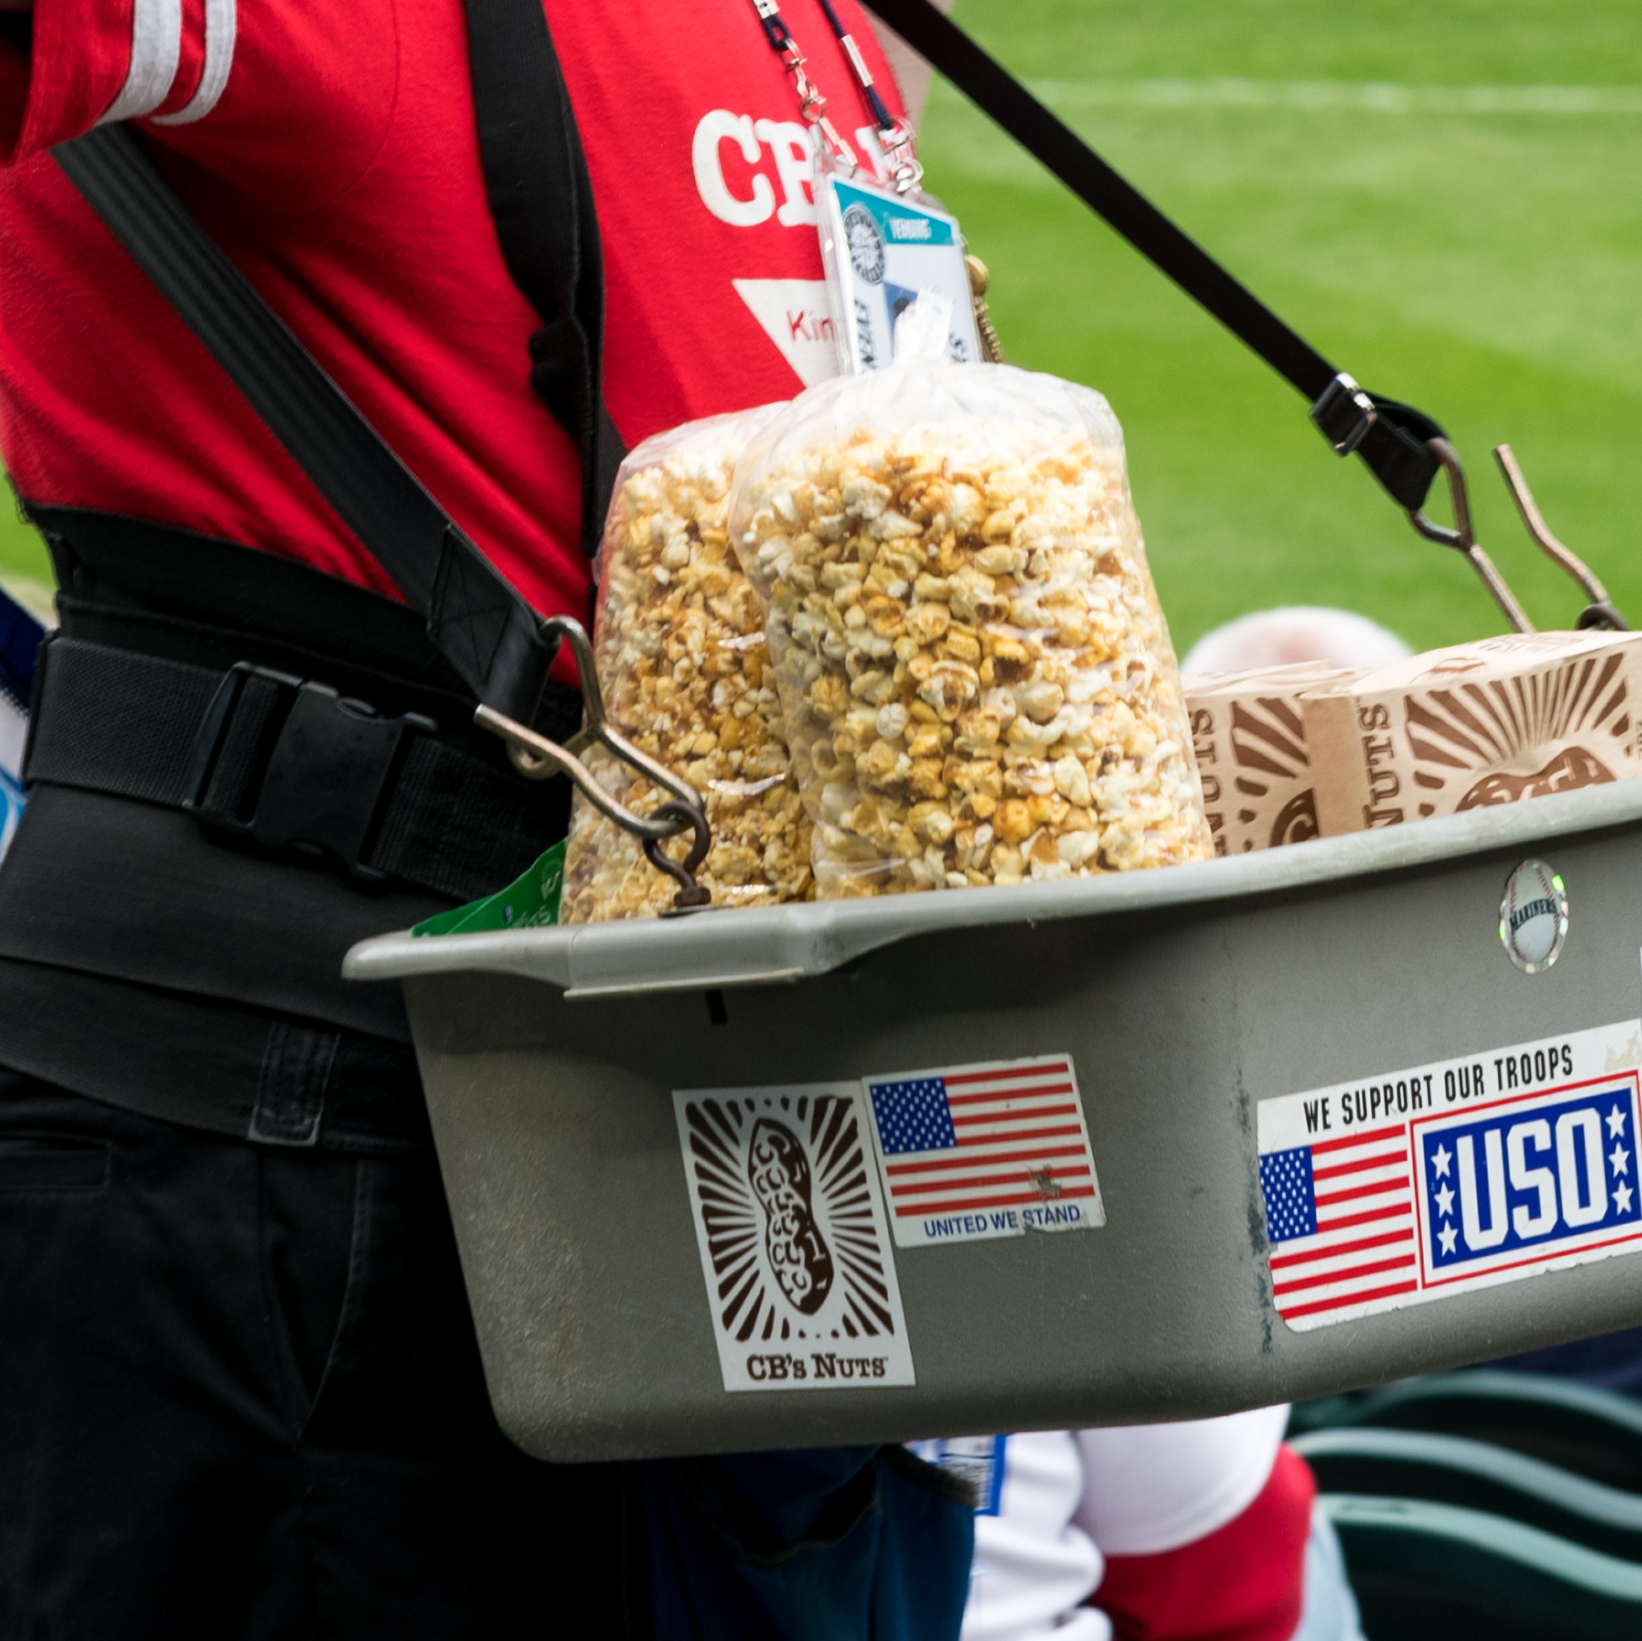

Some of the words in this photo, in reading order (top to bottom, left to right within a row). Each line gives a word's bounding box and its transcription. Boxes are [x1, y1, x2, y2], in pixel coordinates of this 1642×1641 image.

[1509, 898, 1558, 935] MARINERS
[1303, 1097, 1332, 1134] WE
[1341, 1074, 1433, 1125] SUPPORT
[1444, 1063, 1485, 1102] OUR
[1494, 1044, 1573, 1091] TROOPS
[1455, 1106, 1609, 1253] USO
[924, 1215, 988, 1239] UNITED
[988, 1209, 1021, 1231] WE
[1021, 1204, 1081, 1227] STAND
[745, 1354, 808, 1381] CB's
